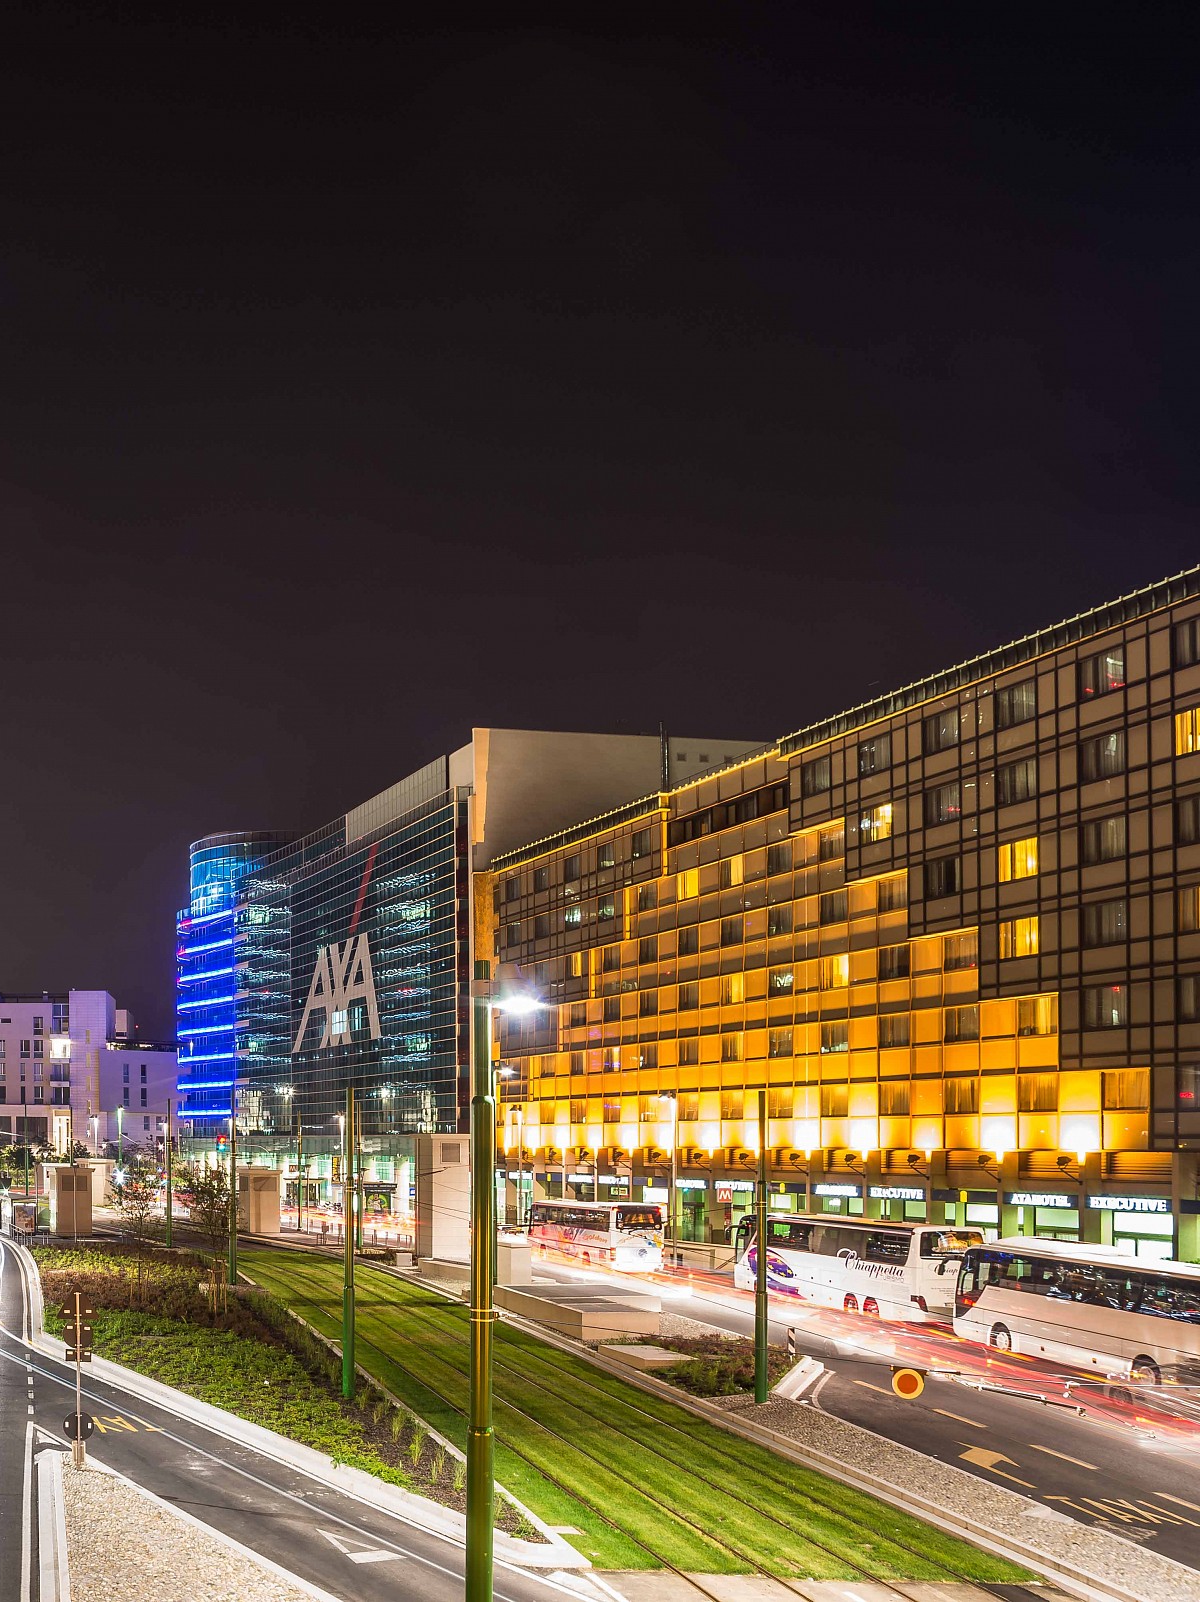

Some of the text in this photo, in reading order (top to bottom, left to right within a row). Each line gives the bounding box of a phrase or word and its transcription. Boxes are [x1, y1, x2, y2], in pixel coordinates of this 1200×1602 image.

[292, 932, 381, 1053] AXA
[870, 1187, 924, 1199] EXECUTIVE
[1090, 1196, 1168, 1212] EXECUTIVE
[837, 1248, 904, 1278] Chiappetta
[91, 1415, 165, 1433] TAX
[1042, 1495, 1200, 1527] TAXI
